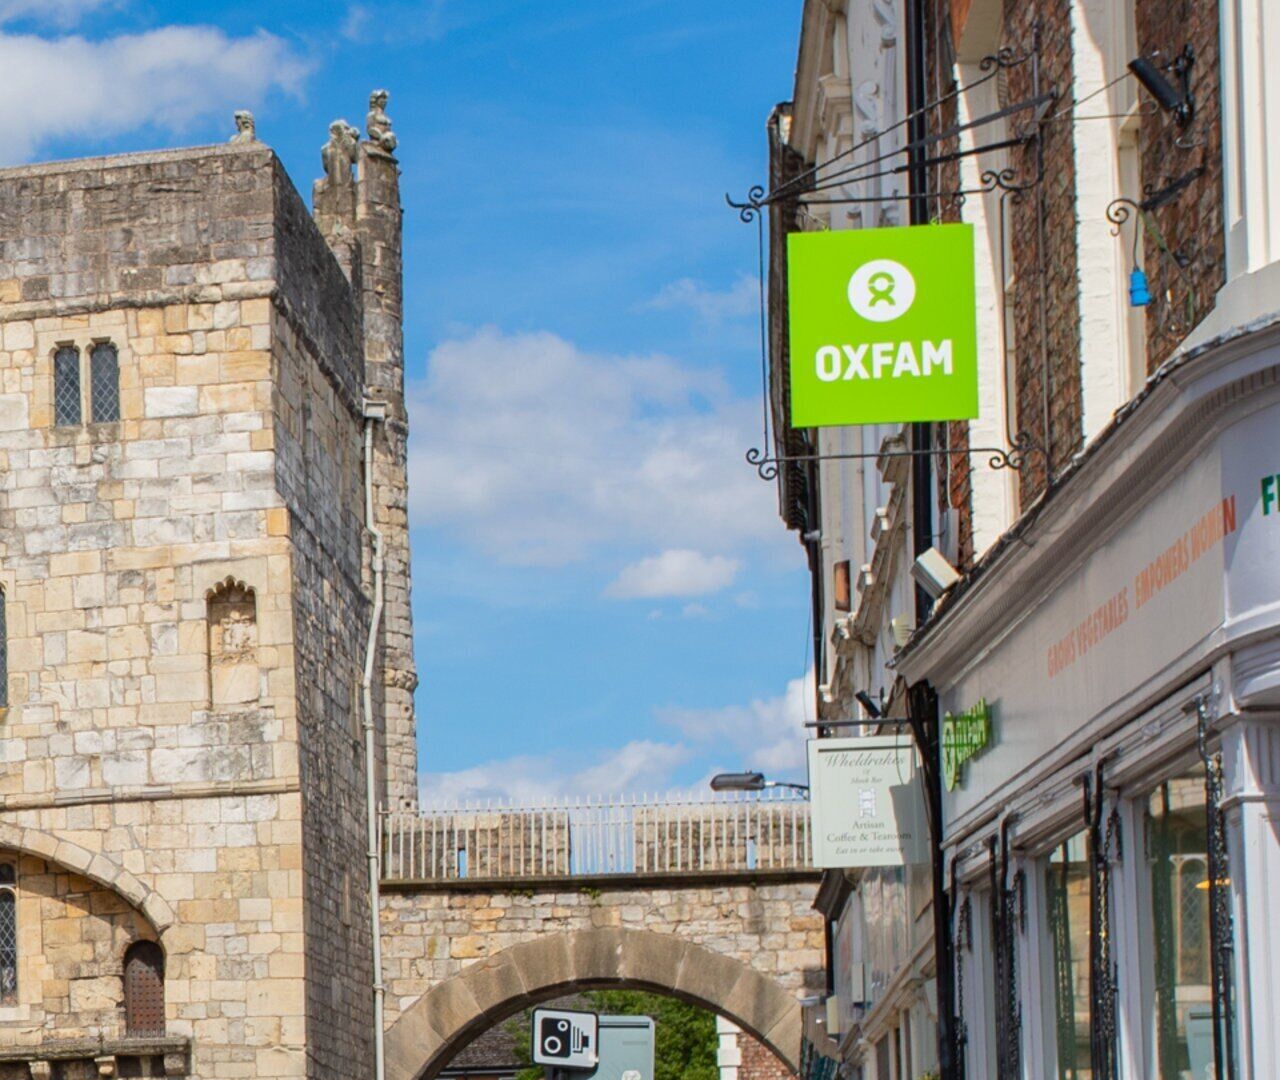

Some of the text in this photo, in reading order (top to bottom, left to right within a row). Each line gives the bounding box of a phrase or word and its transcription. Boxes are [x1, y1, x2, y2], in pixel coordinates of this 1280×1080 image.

[815, 338, 953, 383] OXFAM
[1078, 586, 1129, 657] VEGETABLES
[1135, 532, 1189, 610] EMPOWERS
[1191, 494, 1237, 564] WOMEN
[826, 832, 857, 843] Coffee
[852, 820, 885, 830] Artisan
